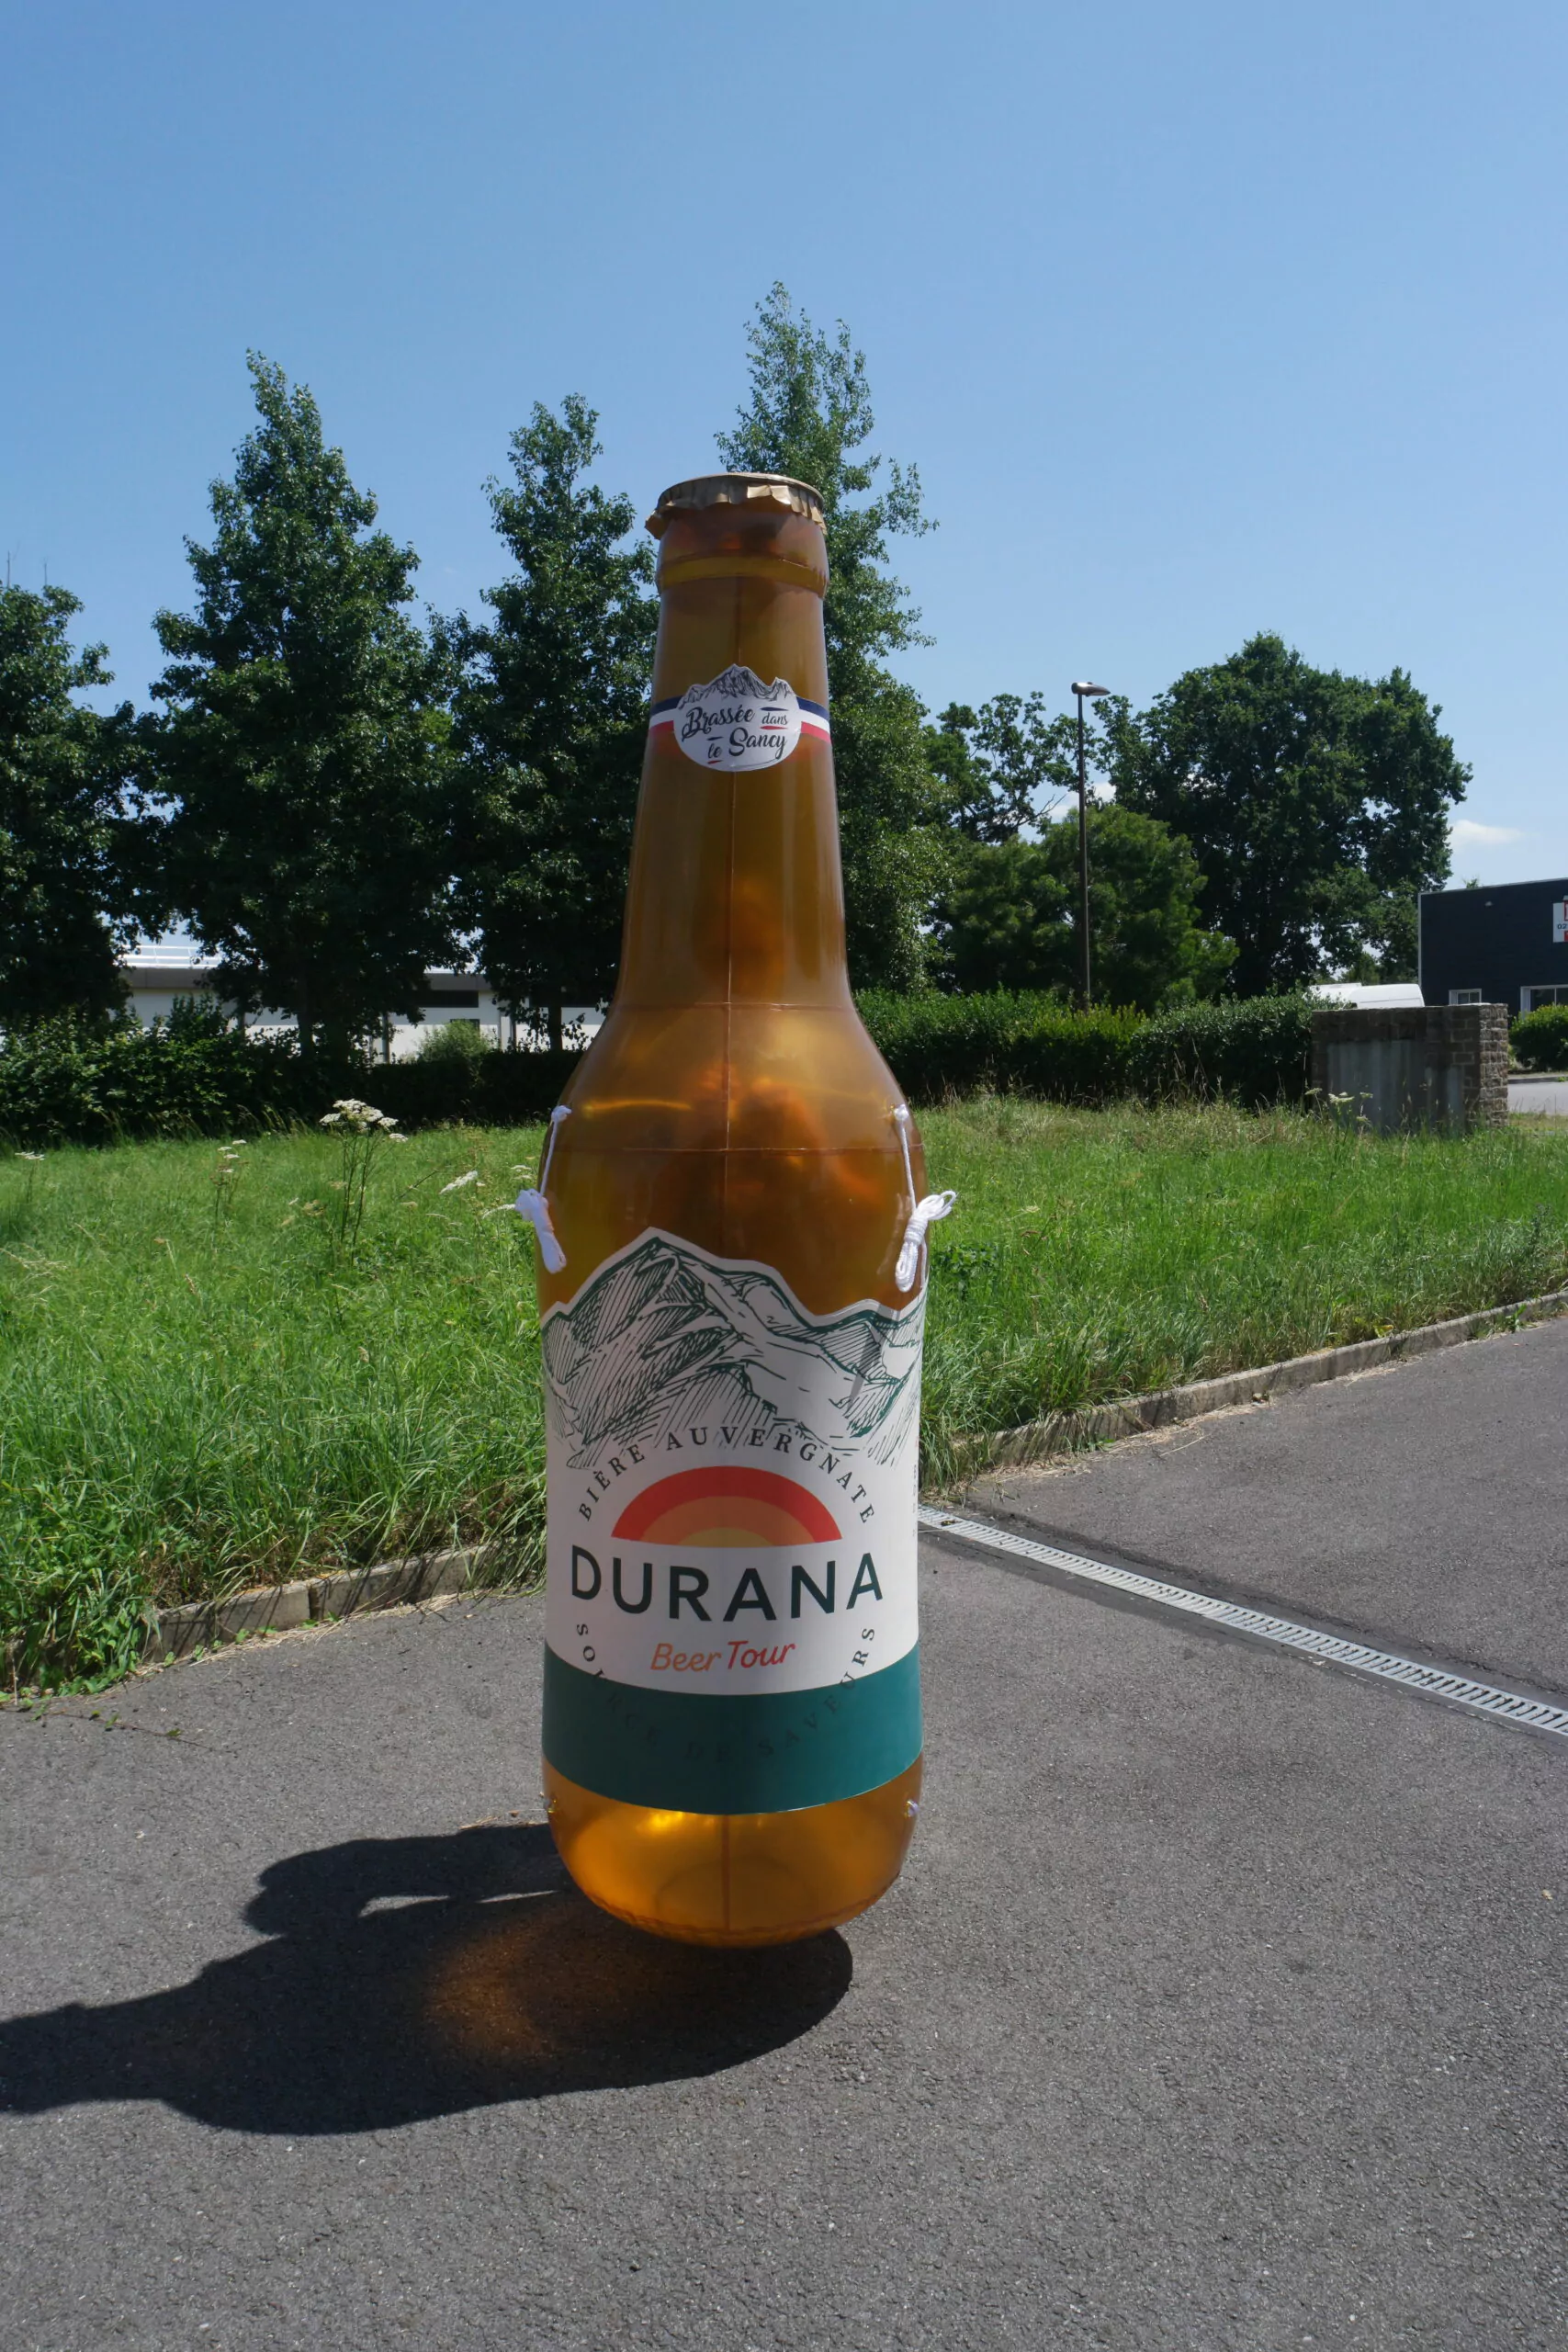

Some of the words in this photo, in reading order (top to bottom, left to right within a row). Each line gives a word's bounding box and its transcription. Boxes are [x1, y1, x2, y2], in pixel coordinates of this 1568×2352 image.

[681, 705, 755, 741] Brassée
[761, 712, 789, 726] dans
[706, 743, 722, 759] le
[728, 728, 788, 761] Sancy
[578, 1444, 646, 1522] BIÈRE
[665, 1426, 875, 1524] AUVERGNATE
[571, 1544, 884, 1623] DURANA
[649, 1643, 722, 1672] Beer
[726, 1639, 797, 1670] Tour
[757, 1626, 876, 1758] SAVEURS
